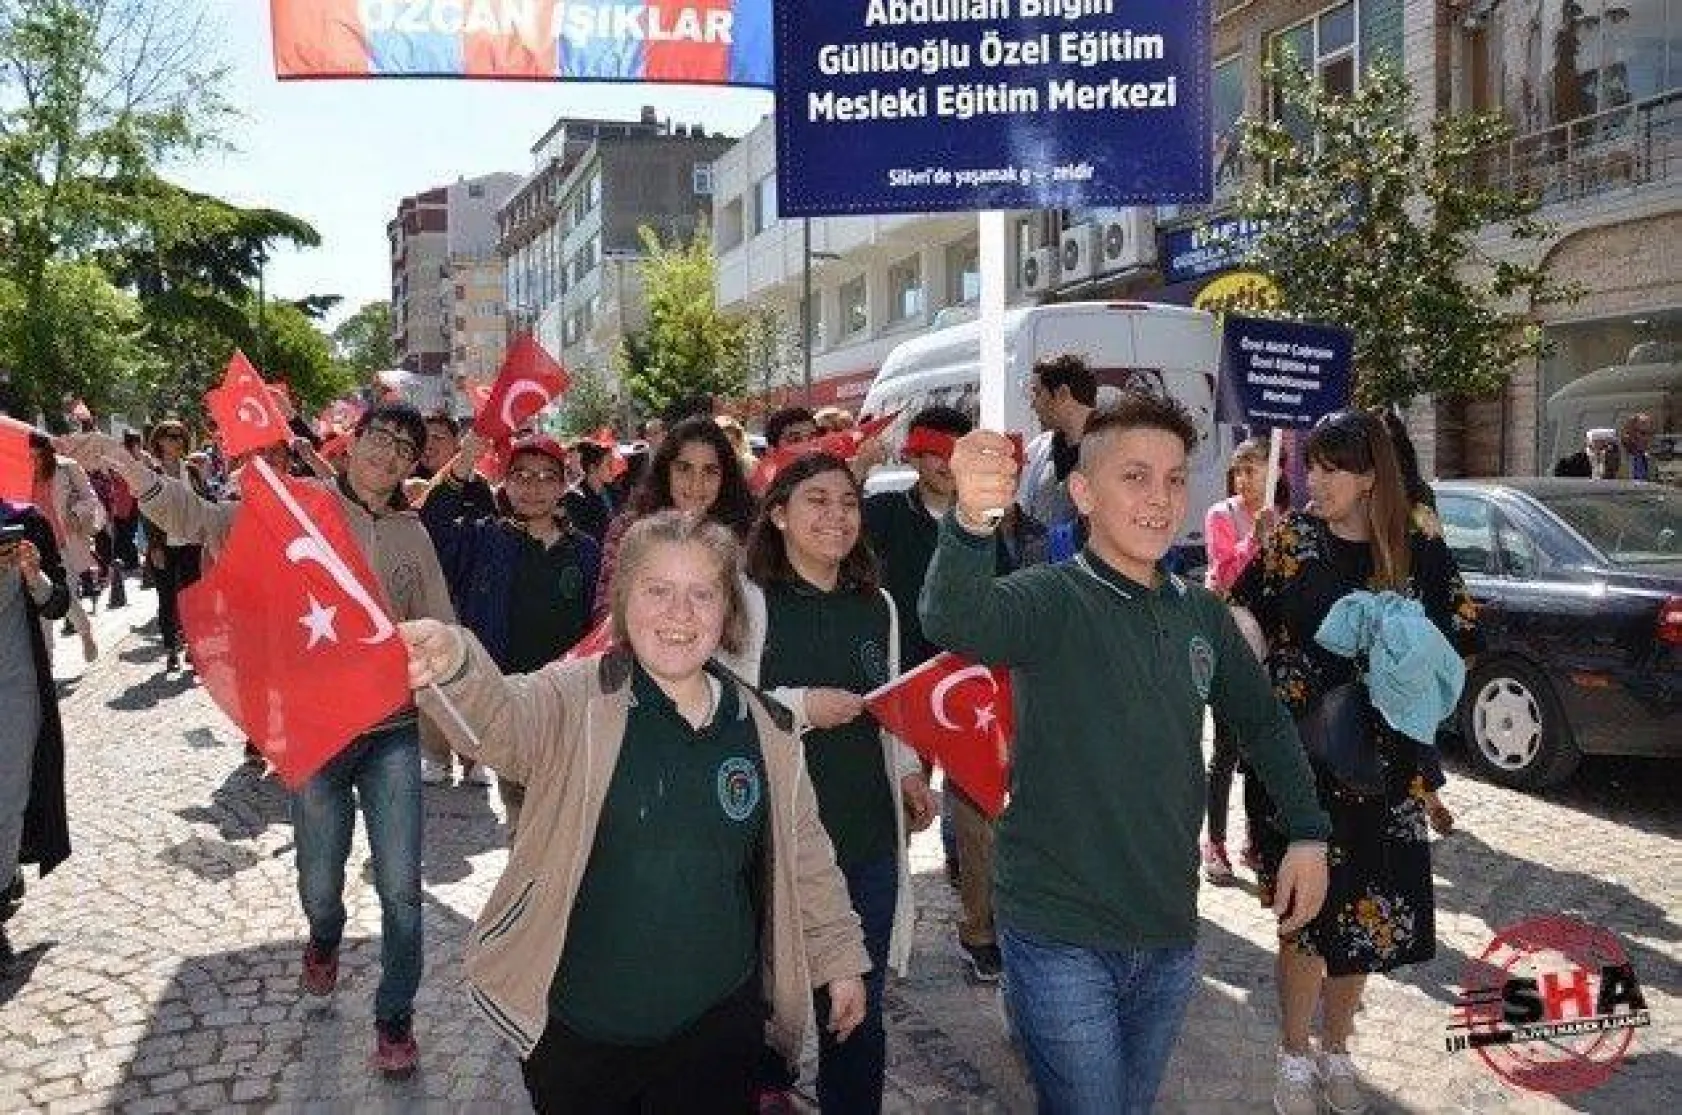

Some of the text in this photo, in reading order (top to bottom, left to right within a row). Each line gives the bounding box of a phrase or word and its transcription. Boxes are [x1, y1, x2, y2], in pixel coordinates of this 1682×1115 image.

[818, 29, 1164, 75] Güllüoğlu Özel Eğitim
[808, 77, 1177, 122] Mesleki Eğitim Merkezi
[954, 164, 1018, 189] yaşamak
